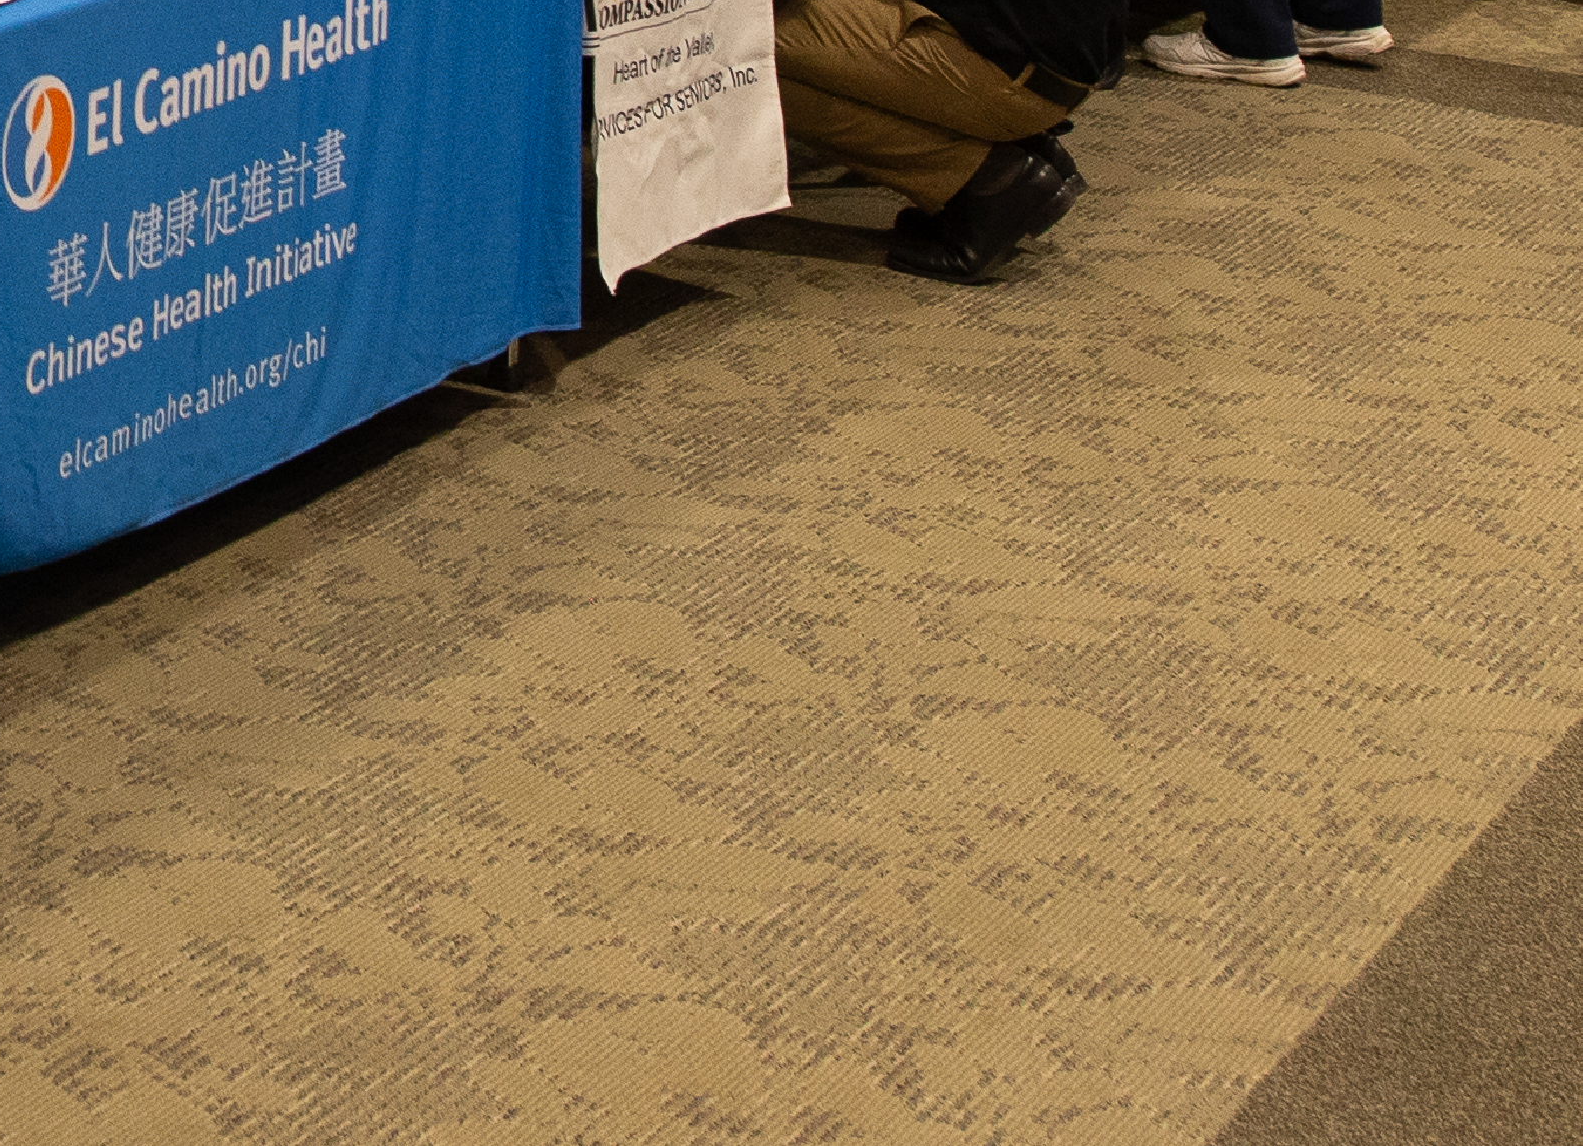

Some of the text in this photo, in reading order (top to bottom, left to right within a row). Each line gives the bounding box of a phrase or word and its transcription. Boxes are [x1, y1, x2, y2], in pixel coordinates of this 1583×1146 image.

[87, 79, 123, 156] El
[135, 40, 271, 135] Camino
[613, 55, 649, 86] Heart
[643, 93, 675, 124] FOR
[728, 66, 757, 88] Inc.
[46, 129, 347, 306] 華人健康促進計畫
[26, 222, 358, 396] Chinese Health Initiative
[59, 326, 327, 478] elcaminohealth.org/chi
